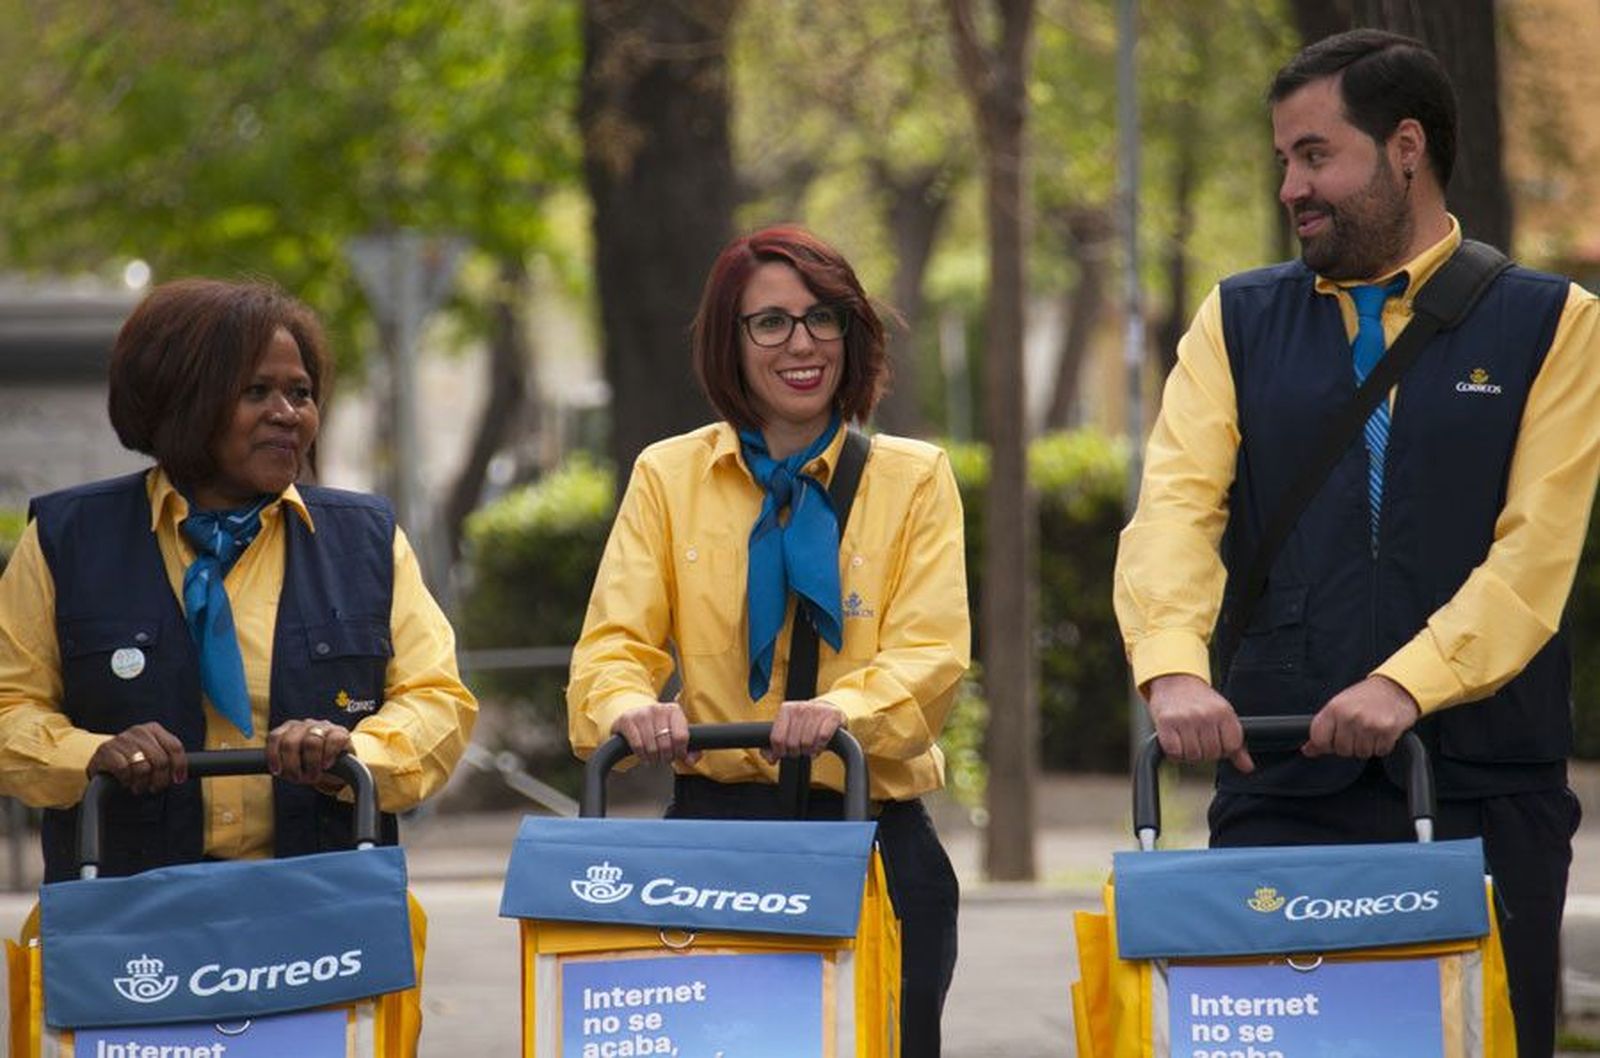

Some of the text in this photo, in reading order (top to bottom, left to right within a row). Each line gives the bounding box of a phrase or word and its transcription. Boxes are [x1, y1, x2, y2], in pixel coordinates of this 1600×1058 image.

[641, 878, 811, 915] Correos
[1285, 890, 1439, 921] CORREOS
[189, 949, 363, 996] Correos
[583, 980, 707, 1011] Internet
[1190, 993, 1319, 1017] Internet
[583, 1012, 663, 1035] no se
[1191, 1023, 1275, 1043] no se
[97, 1040, 226, 1058] Internet
[582, 1034, 679, 1058] acaba,
